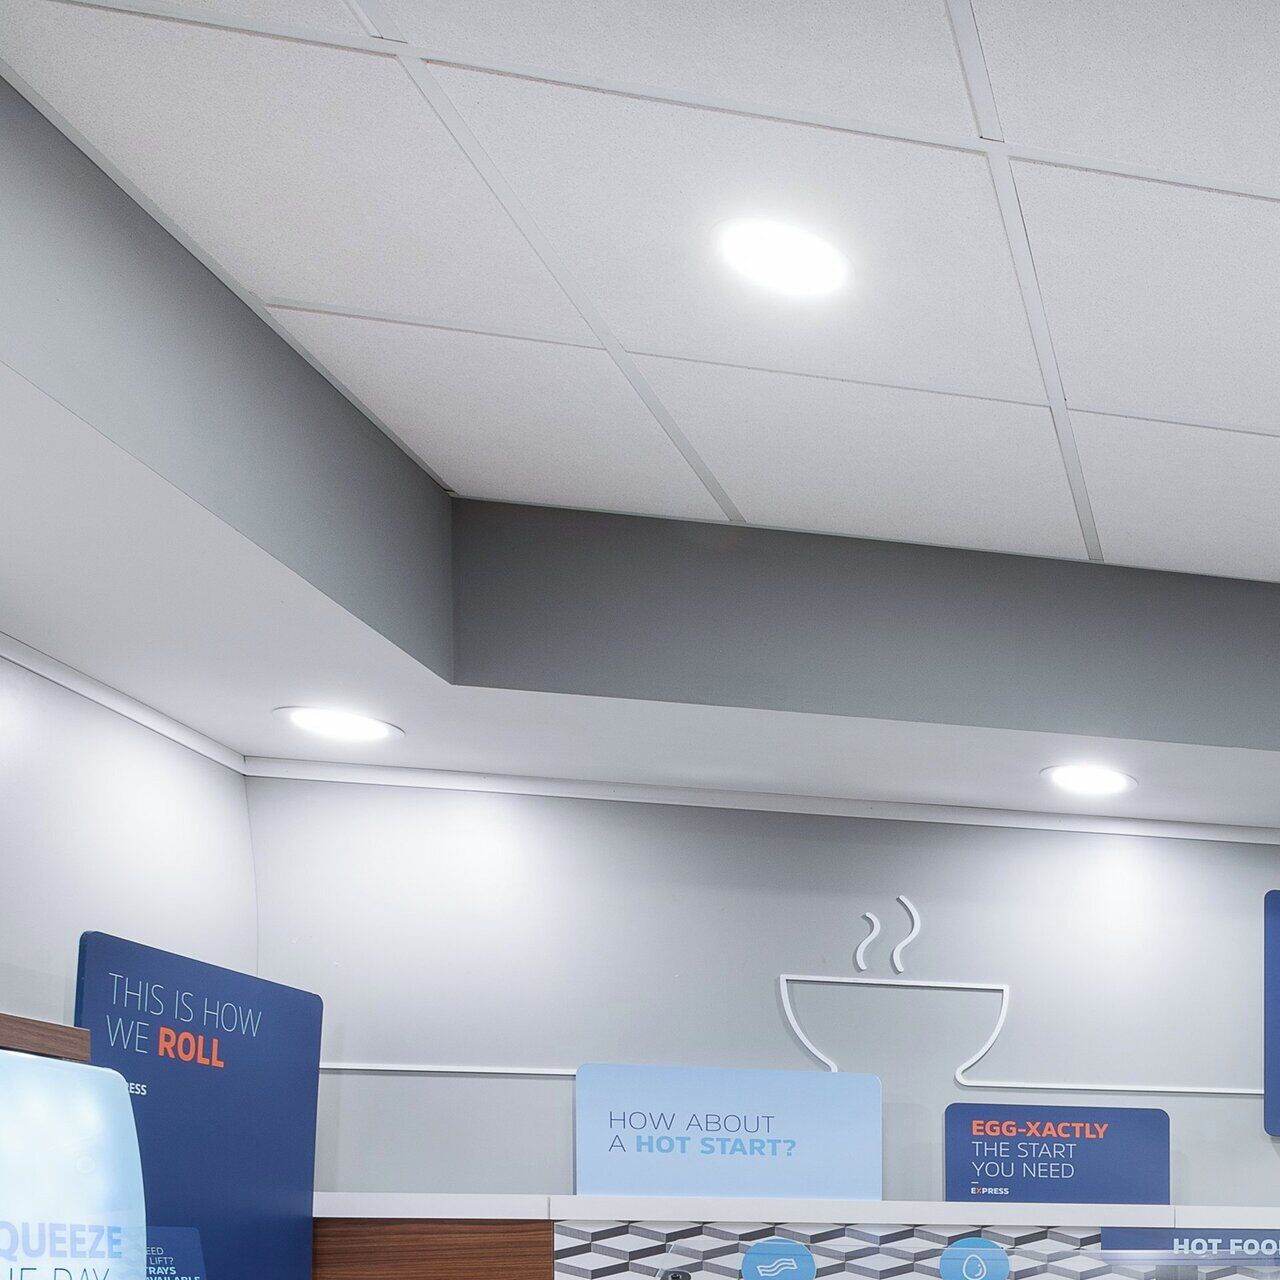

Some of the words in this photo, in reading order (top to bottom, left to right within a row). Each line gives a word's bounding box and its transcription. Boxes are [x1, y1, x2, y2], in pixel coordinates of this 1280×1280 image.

[108, 972, 164, 1017] THIS
[175, 989, 194, 1023] IS
[204, 999, 263, 1039] HOW
[106, 1014, 149, 1054] WE
[157, 1027, 225, 1069] ROLL
[609, 1110, 676, 1133] HOW
[688, 1113, 775, 1136] ABOUT
[971, 1119, 1109, 1140] EGG-XACTLY
[608, 1133, 627, 1153] A
[635, 1135, 691, 1155] HOT
[701, 1137, 798, 1158] START?
[972, 1141, 1011, 1158] THE
[1017, 1142, 1076, 1160] START
[972, 1161, 1016, 1178] YOU
[1022, 1162, 1075, 1179] NEED
[971, 1186, 1010, 1196] EXPRESS
[0, 1221, 122, 1262] QUEEZE
[146, 1247, 164, 1256] EED
[1173, 1238, 1223, 1256] HOT
[149, 1256, 174, 1265] LIFT?
